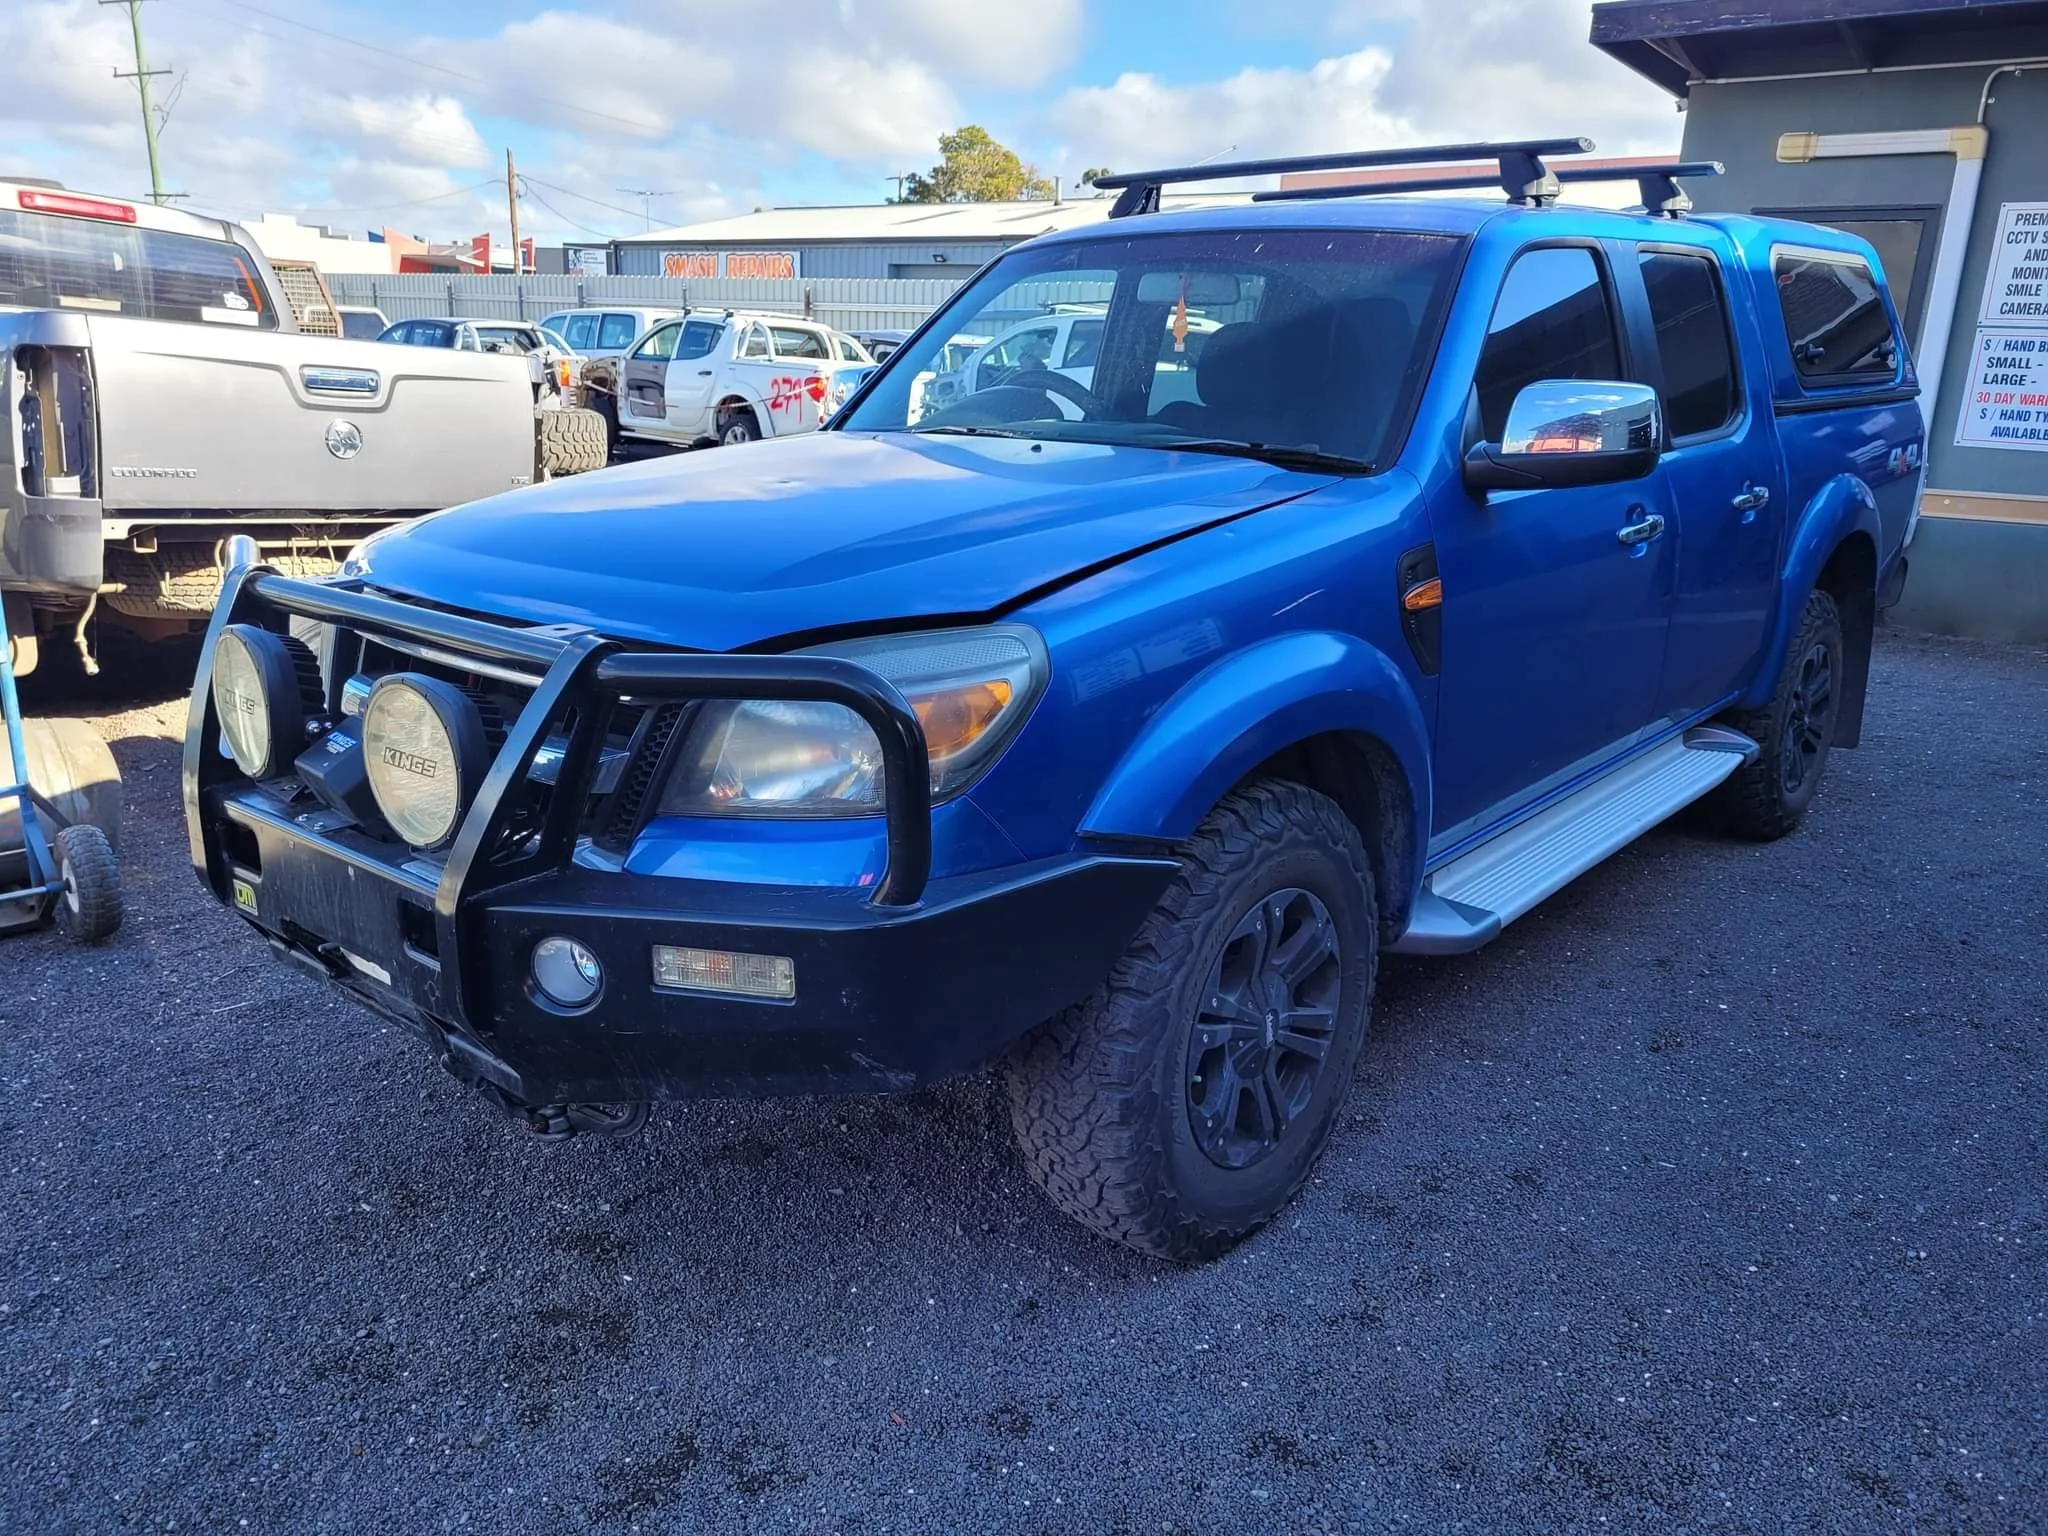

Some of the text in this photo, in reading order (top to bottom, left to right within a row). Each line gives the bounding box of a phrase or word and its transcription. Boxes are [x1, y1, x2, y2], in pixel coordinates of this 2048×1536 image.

[2006, 231, 2039, 244] CCTV
[2023, 248, 2048, 261] AND
[664, 253, 795, 279] SMASH REPAIRS
[2005, 283, 2043, 296] SMILE
[1999, 302, 2048, 315] CAMERA
[1983, 339, 1992, 351] S
[2003, 339, 2035, 352] HAND
[2037, 340, 2048, 352] B
[1986, 356, 2032, 369] SMALL
[1982, 373, 2028, 386] LARGE
[1976, 392, 1990, 404] 30
[1994, 393, 2016, 405] DAY
[1979, 408, 1988, 420] S
[1999, 409, 2031, 422] HAND
[1990, 425, 2048, 440] AVAILABLE
[111, 466, 198, 479] COLORADO
[383, 746, 437, 779] KINGS
